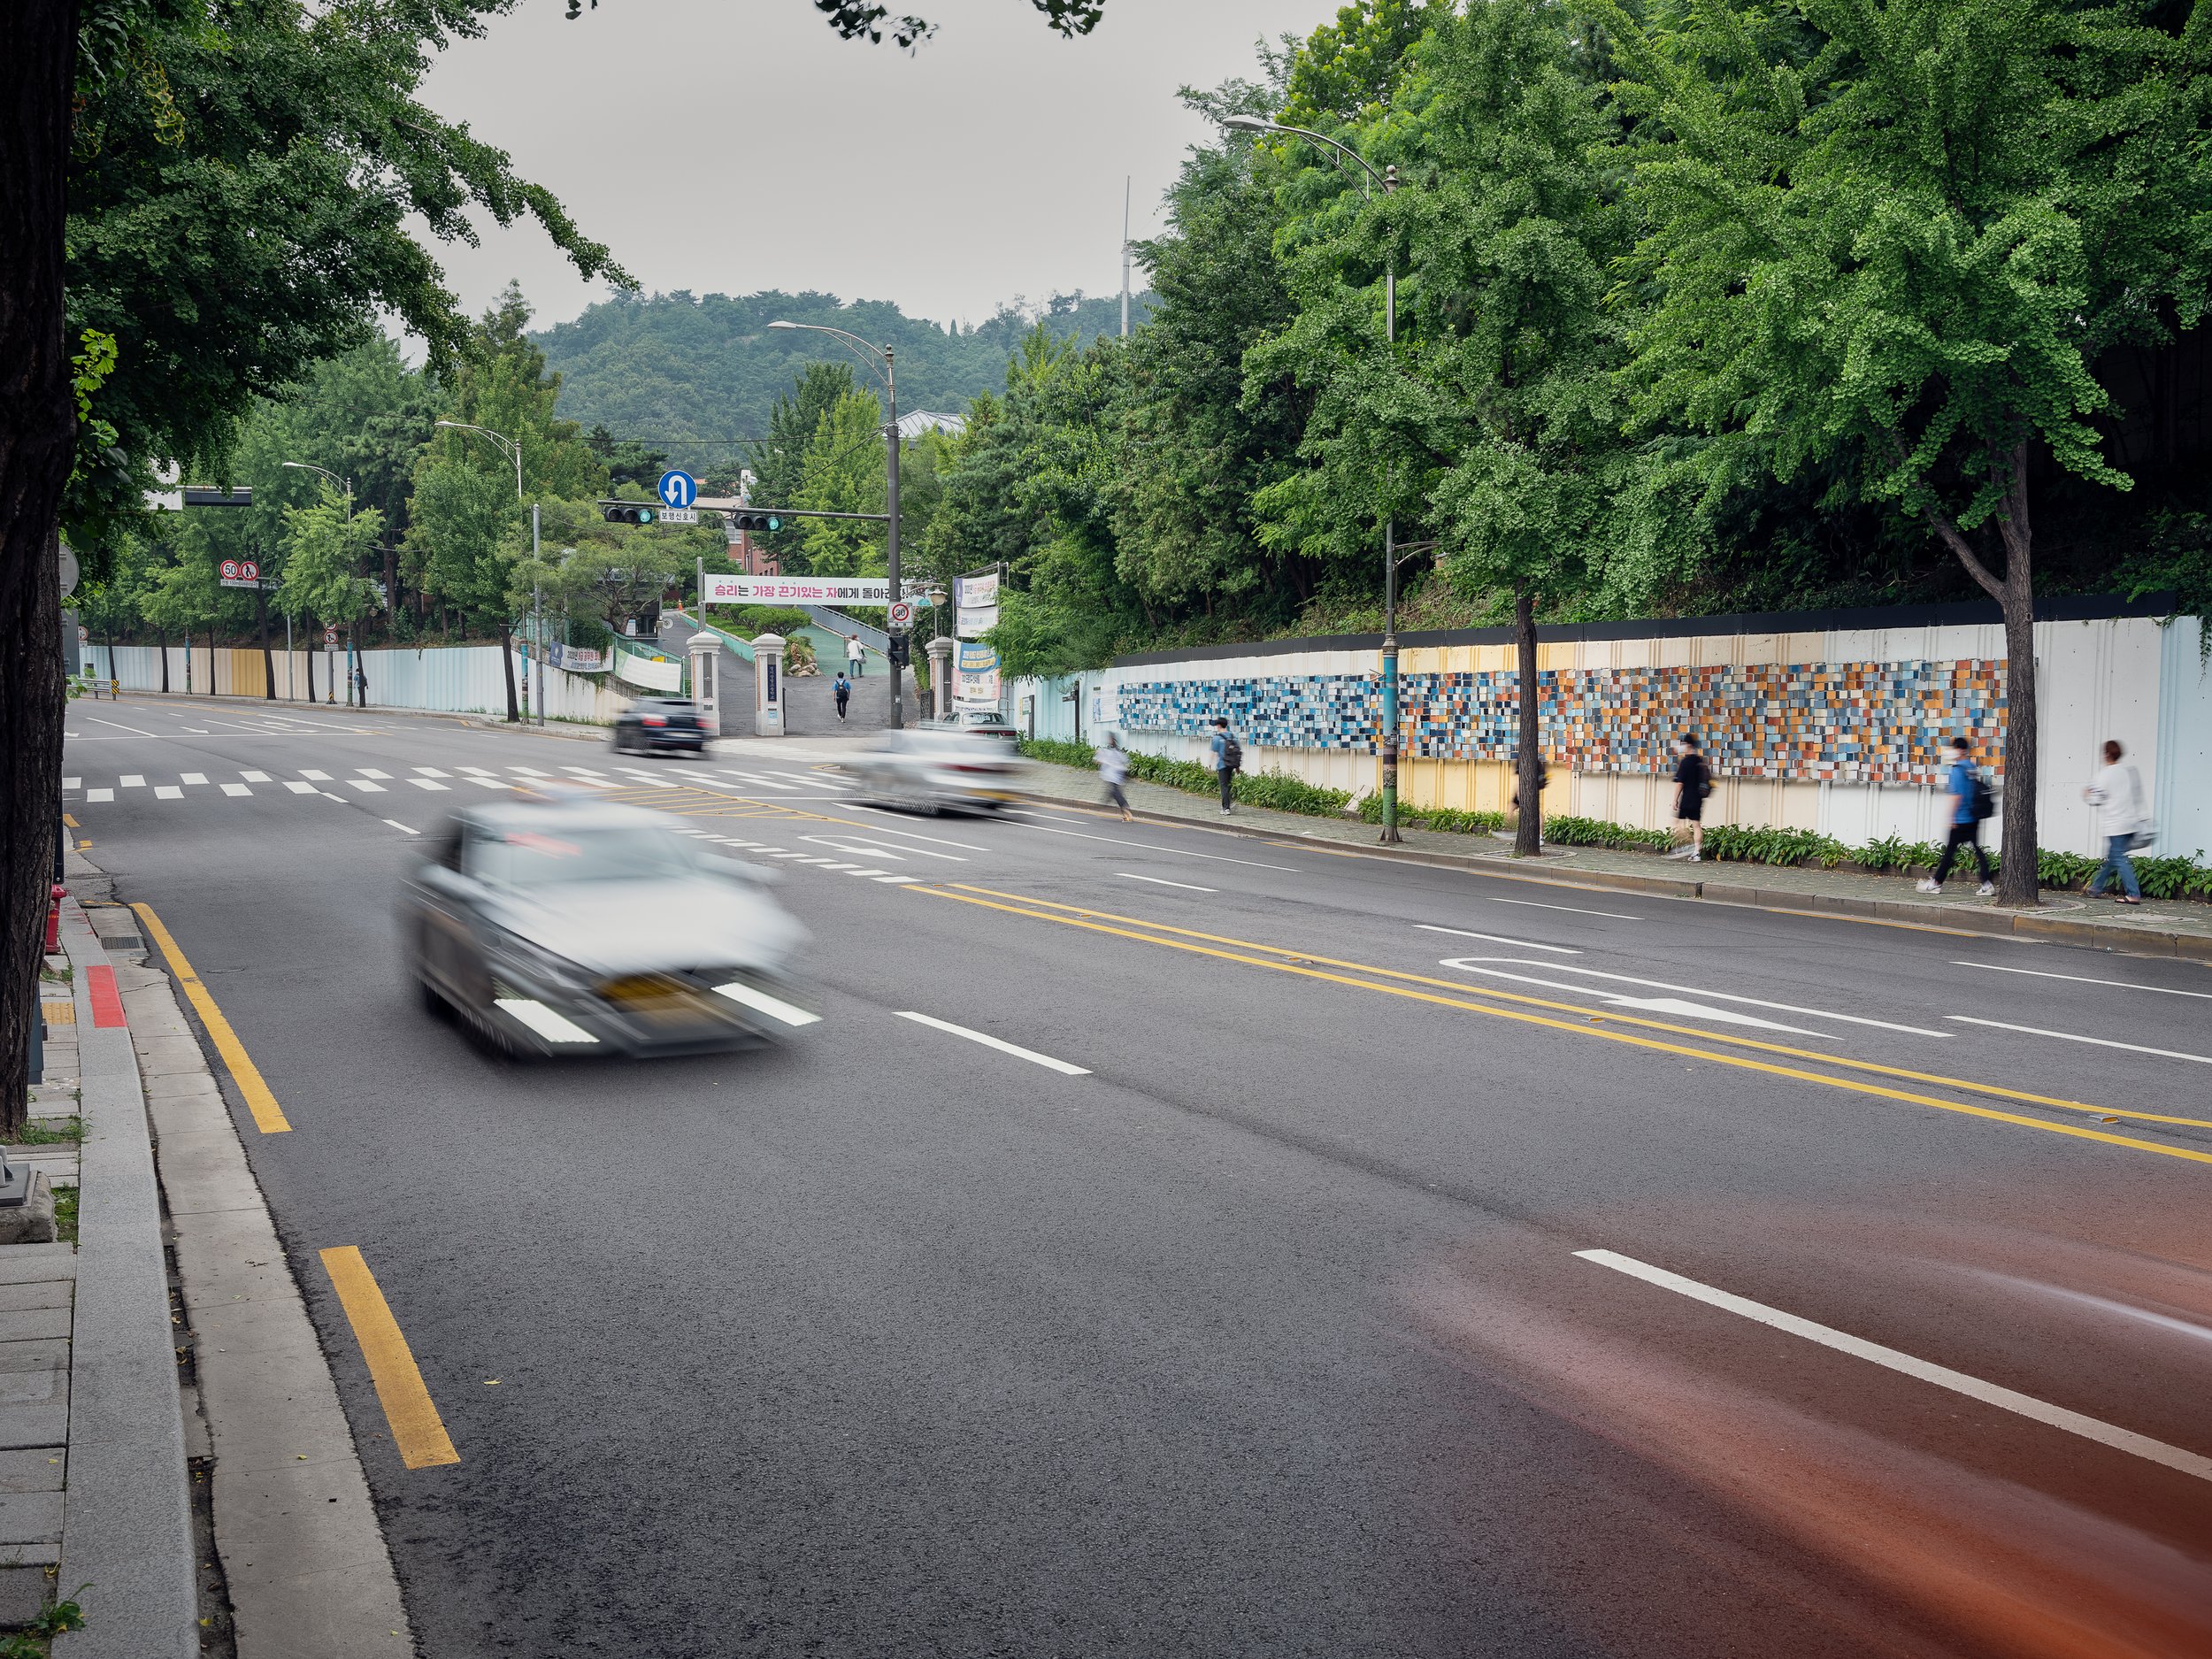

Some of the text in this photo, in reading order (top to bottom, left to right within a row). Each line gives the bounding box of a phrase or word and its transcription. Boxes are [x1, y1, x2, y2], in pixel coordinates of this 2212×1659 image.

[662, 512, 695, 521] 보행신호시
[225, 565, 235, 575] 50
[715, 584, 749, 596] 승리는
[753, 585, 775, 597] 가장
[779, 586, 823, 598] 끈기있는
[826, 587, 859, 599] 자에게
